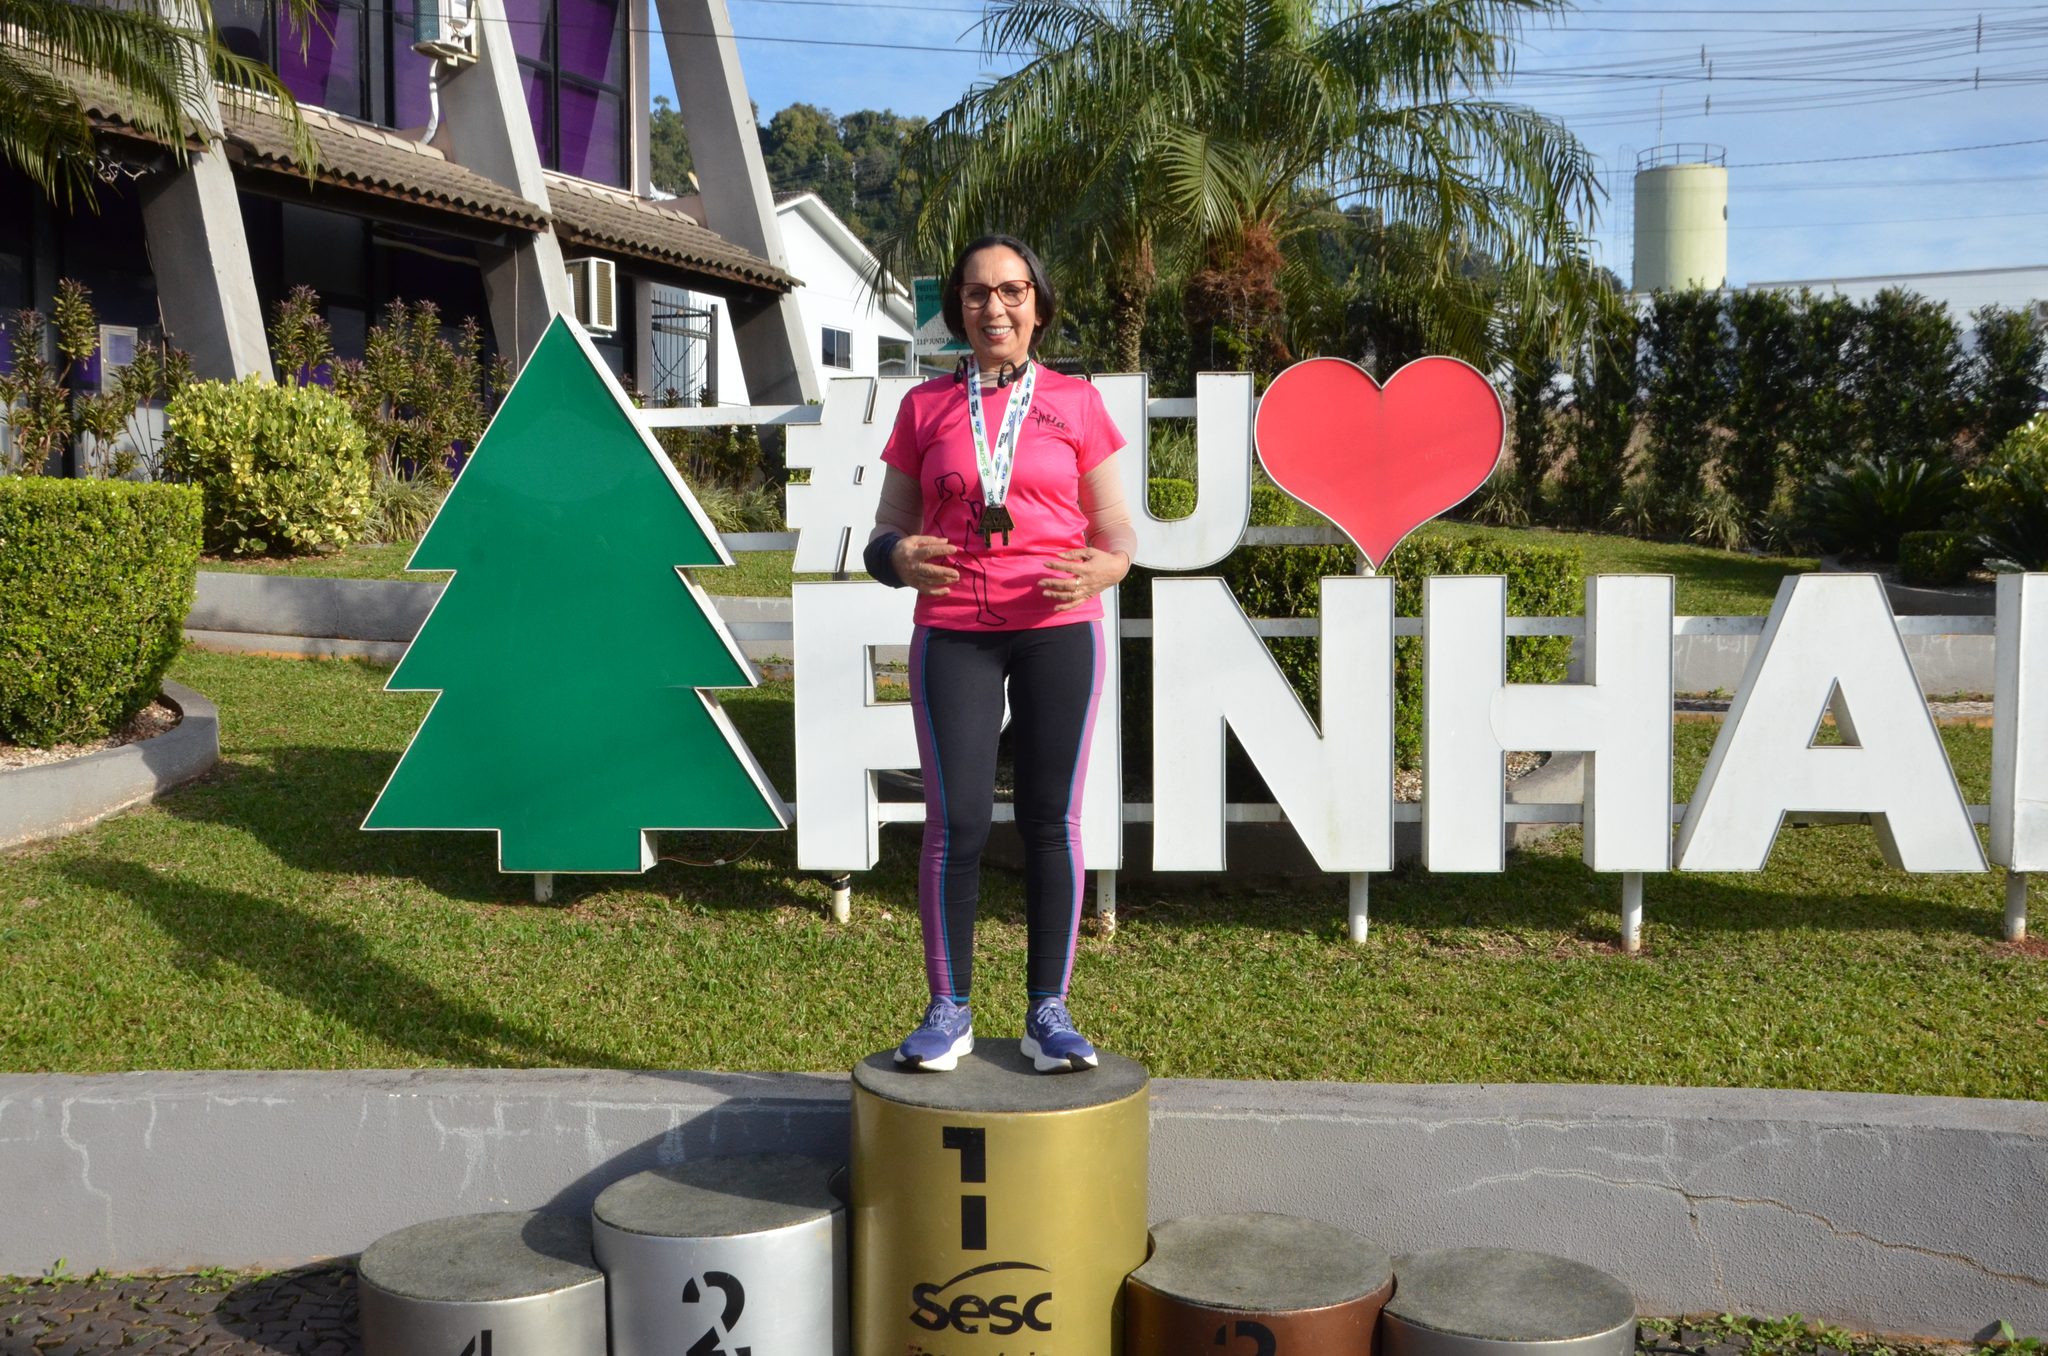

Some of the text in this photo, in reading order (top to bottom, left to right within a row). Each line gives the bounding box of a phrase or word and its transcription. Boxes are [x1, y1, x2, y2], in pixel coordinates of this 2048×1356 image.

[929, 337, 946, 345] JUNTA
[942, 1126, 987, 1250] 1
[681, 1271, 751, 1356] 2
[909, 1262, 1053, 1335] Sesc
